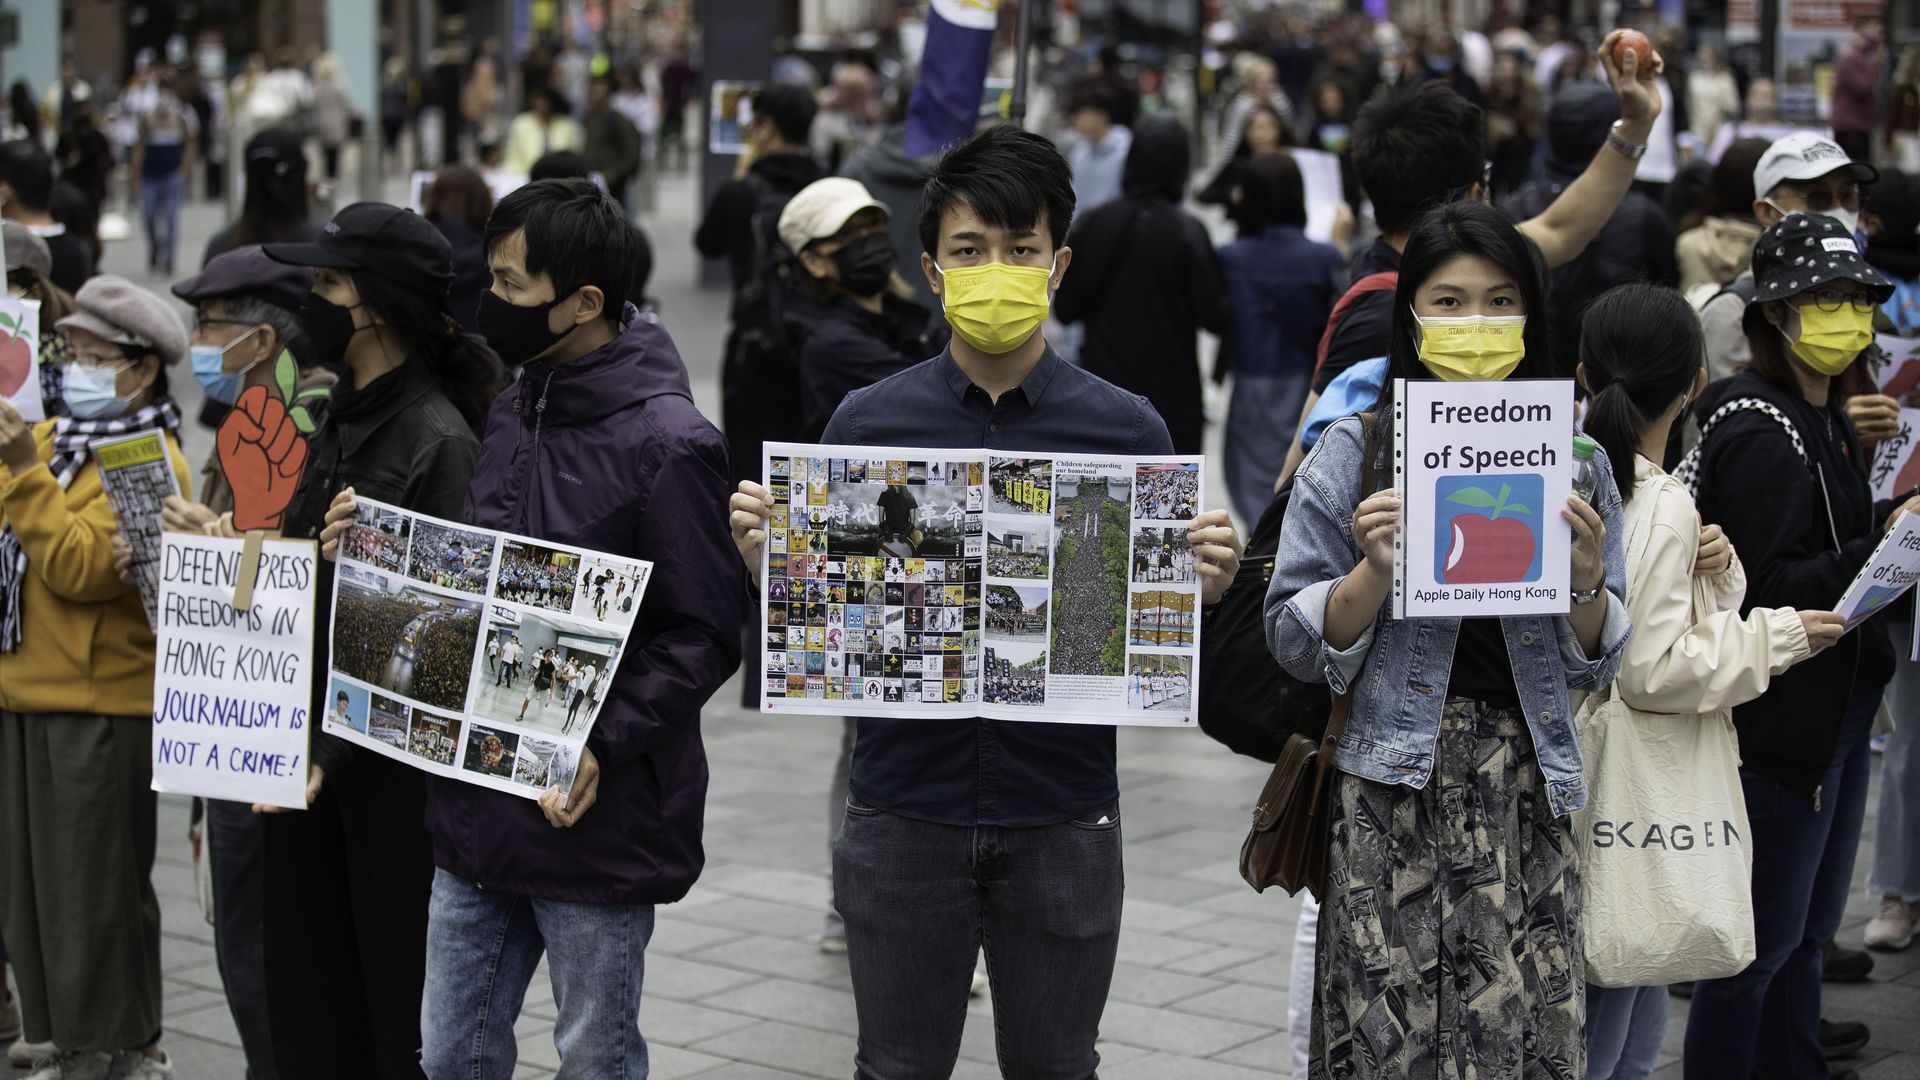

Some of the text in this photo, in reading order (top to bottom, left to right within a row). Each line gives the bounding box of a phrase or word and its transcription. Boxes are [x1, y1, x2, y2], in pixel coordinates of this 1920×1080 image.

[1431, 399, 1552, 424] Freedom
[1056, 460, 1122, 470] Children safeguarding
[1067, 467, 1097, 475] homeland
[1423, 443, 1556, 473] of Speech
[826, 500, 967, 529] 時代 革命
[253, 552, 313, 591] PRESS
[1872, 563, 1895, 581] of
[1414, 586, 1557, 602] Apple Daily Hong Kong
[164, 592, 300, 636] FREEDOMS IN
[163, 637, 299, 685] HONG KONG
[153, 687, 306, 730] JOURNALISM IS
[158, 737, 299, 777] NOT A CRIME!
[1592, 820, 1742, 851] SKAGEN
